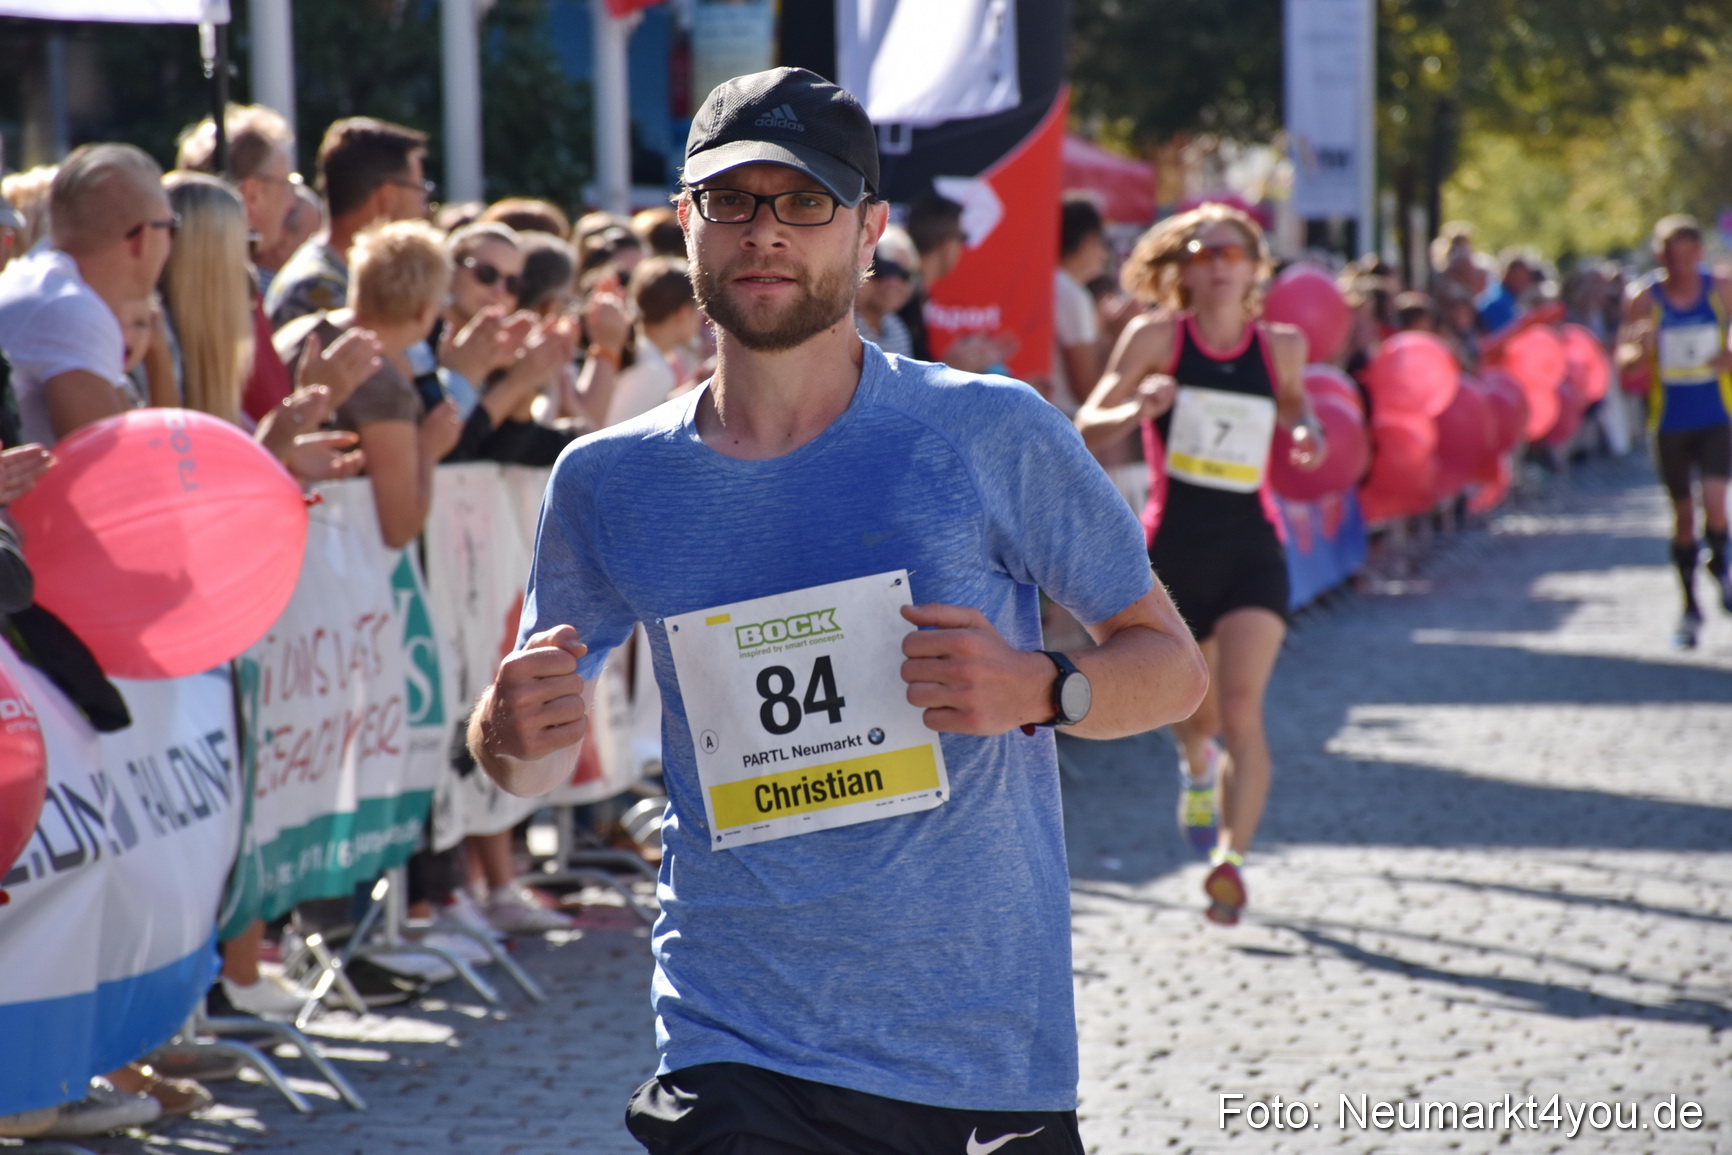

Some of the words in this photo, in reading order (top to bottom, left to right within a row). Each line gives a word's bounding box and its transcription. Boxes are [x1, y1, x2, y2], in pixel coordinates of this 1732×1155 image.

[754, 117, 805, 132] adidas
[1214, 419, 1233, 448] 7
[735, 607, 842, 649] BOCK
[739, 646, 772, 659] inspired
[773, 644, 783, 653] by
[785, 639, 808, 651] smart
[809, 633, 845, 646] concepts
[756, 655, 846, 735] 84
[706, 736, 714, 749] A
[743, 748, 789, 768] PARTL
[792, 735, 863, 758] Neumarkt
[755, 768, 884, 813] Christian
